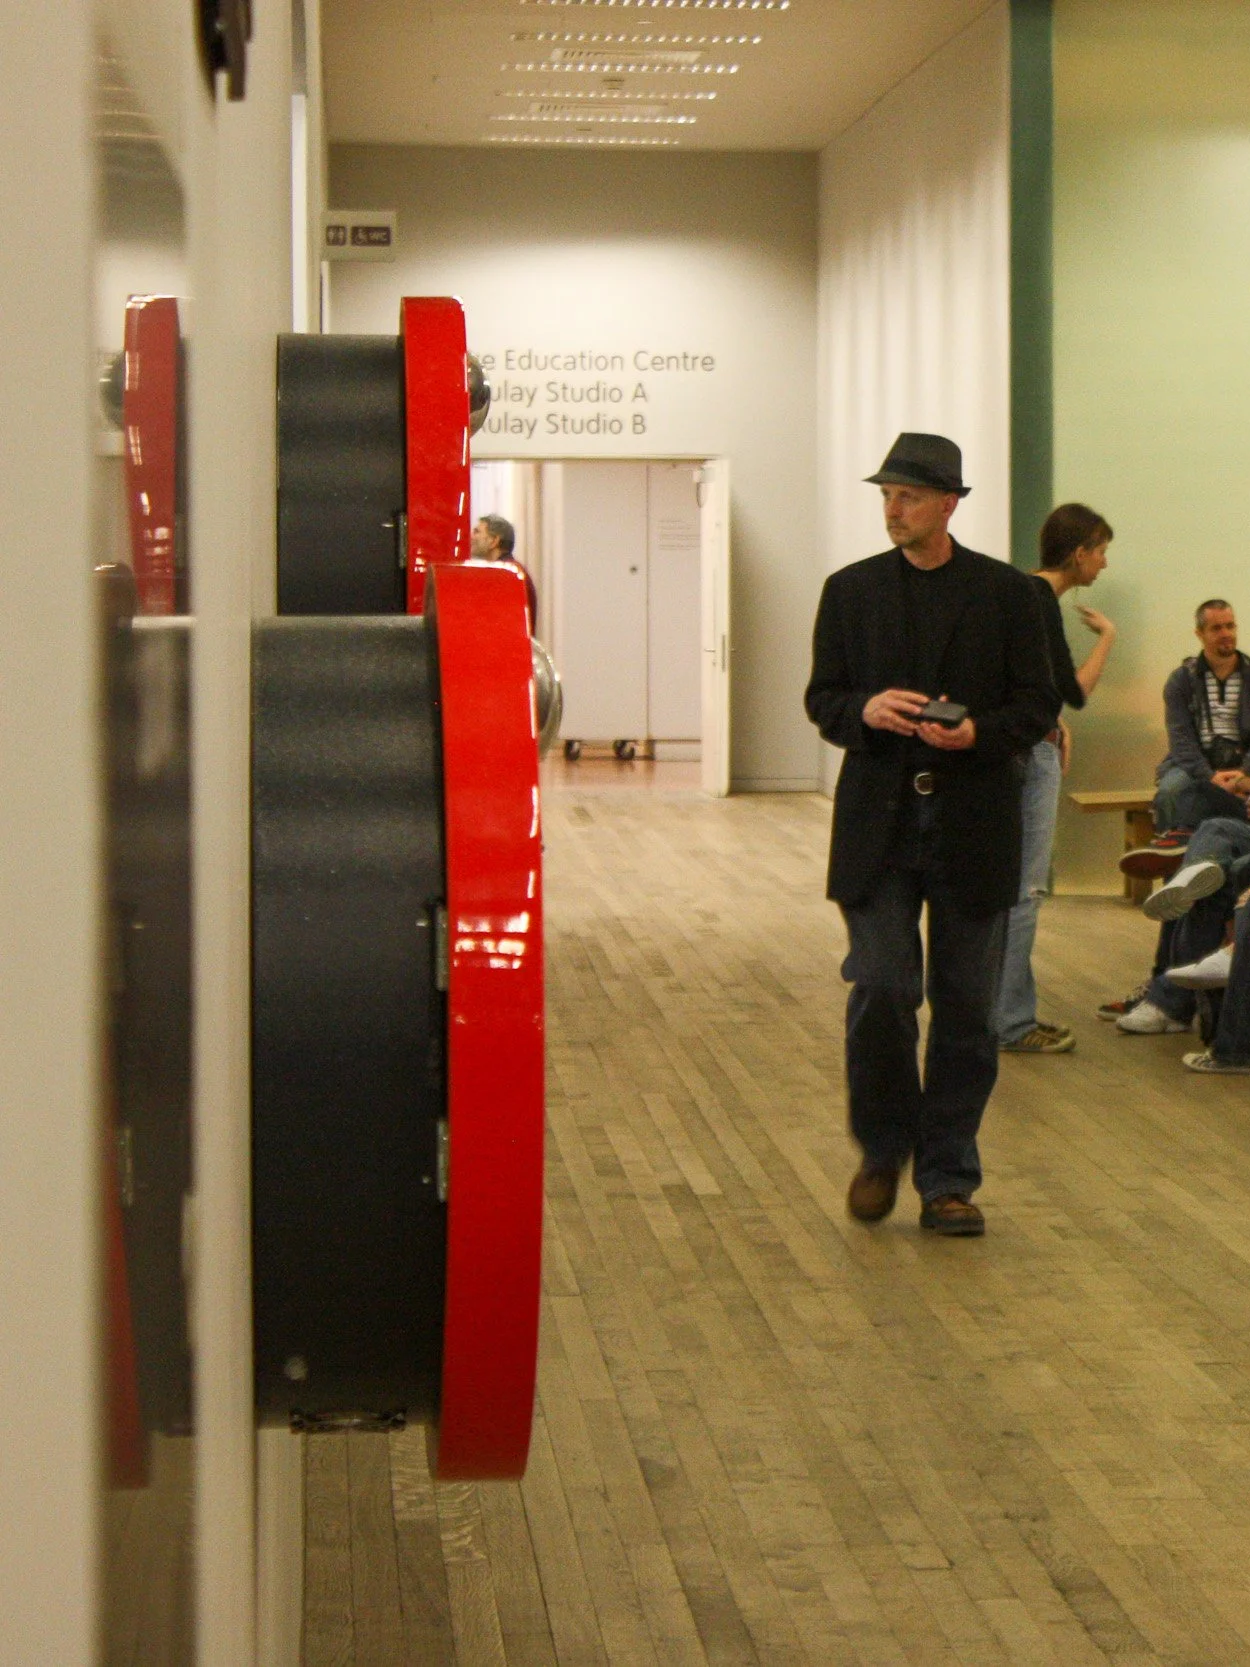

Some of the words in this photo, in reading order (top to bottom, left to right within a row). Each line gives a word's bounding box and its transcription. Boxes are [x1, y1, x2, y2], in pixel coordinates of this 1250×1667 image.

[504, 348, 624, 371] Education
[633, 350, 716, 372] Centre
[489, 380, 538, 408] ulay
[546, 381, 623, 403] Studio
[631, 382, 649, 402] A
[483, 412, 538, 439] ulay
[546, 412, 623, 435] Studio
[632, 413, 647, 435] B
